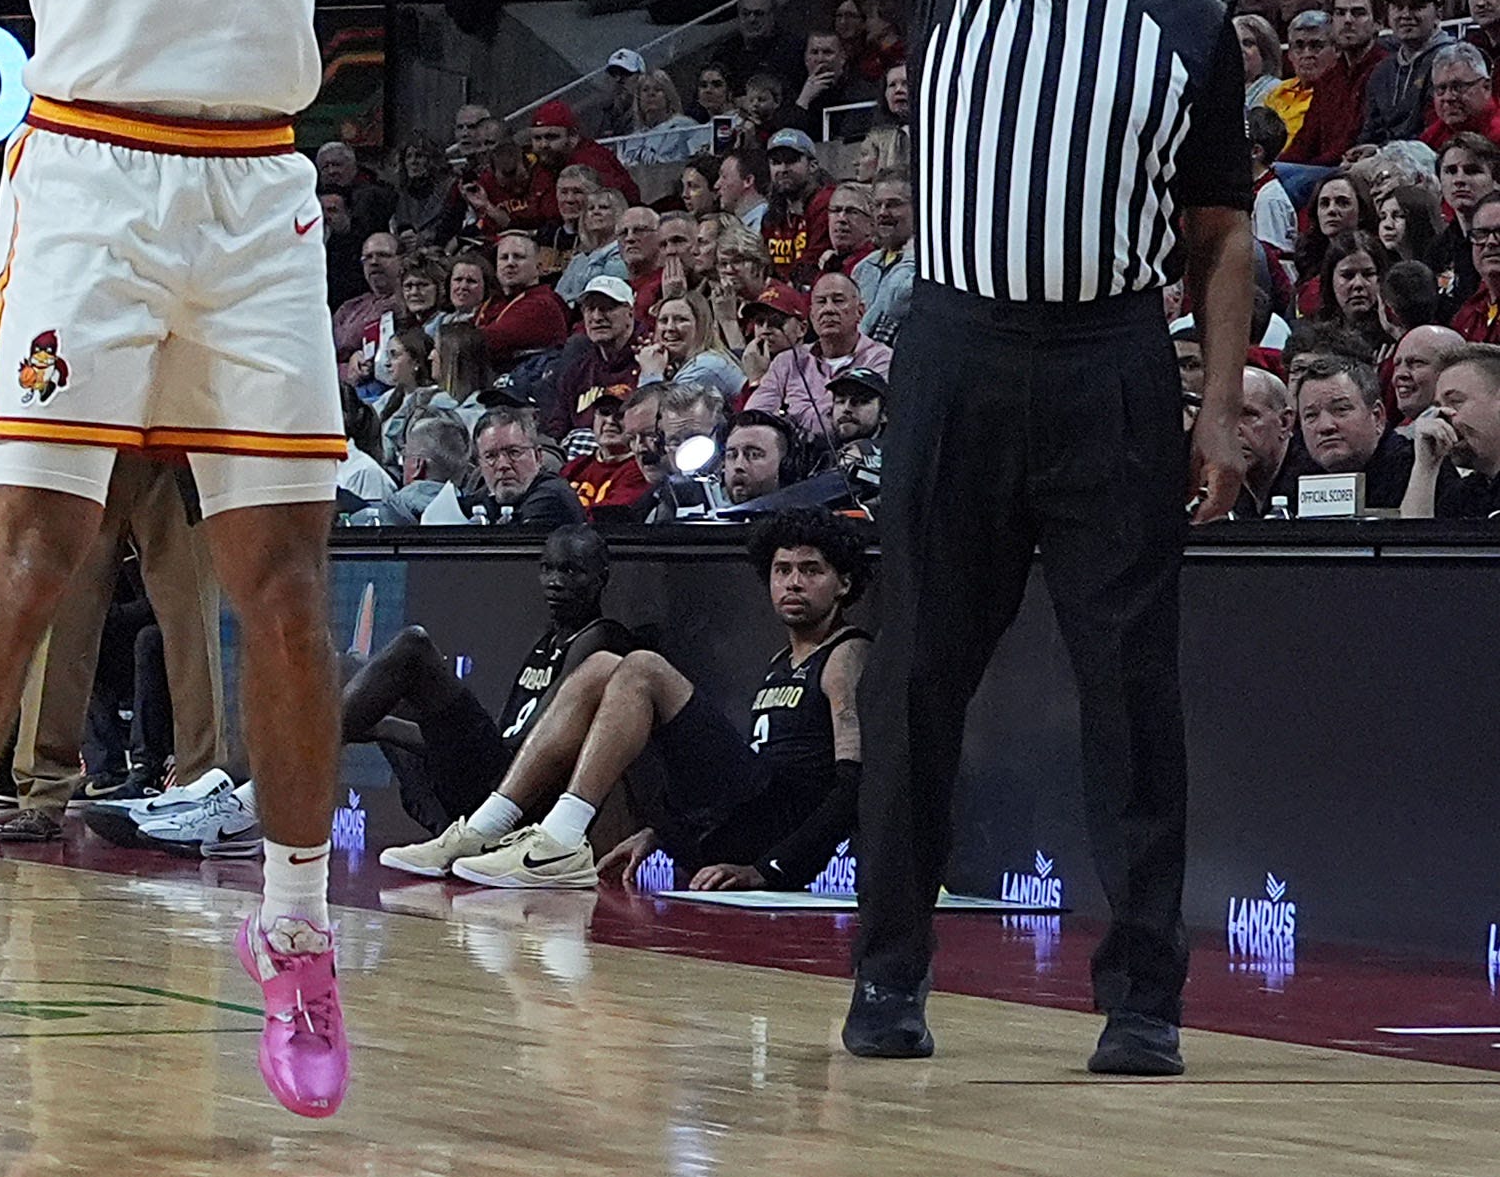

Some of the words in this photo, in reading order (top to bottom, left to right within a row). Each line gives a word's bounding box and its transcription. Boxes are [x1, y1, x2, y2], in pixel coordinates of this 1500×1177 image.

[332, 808, 366, 834] ANDUS
[1001, 872, 1062, 909] LANDUS
[1227, 896, 1297, 937] LANDUS
